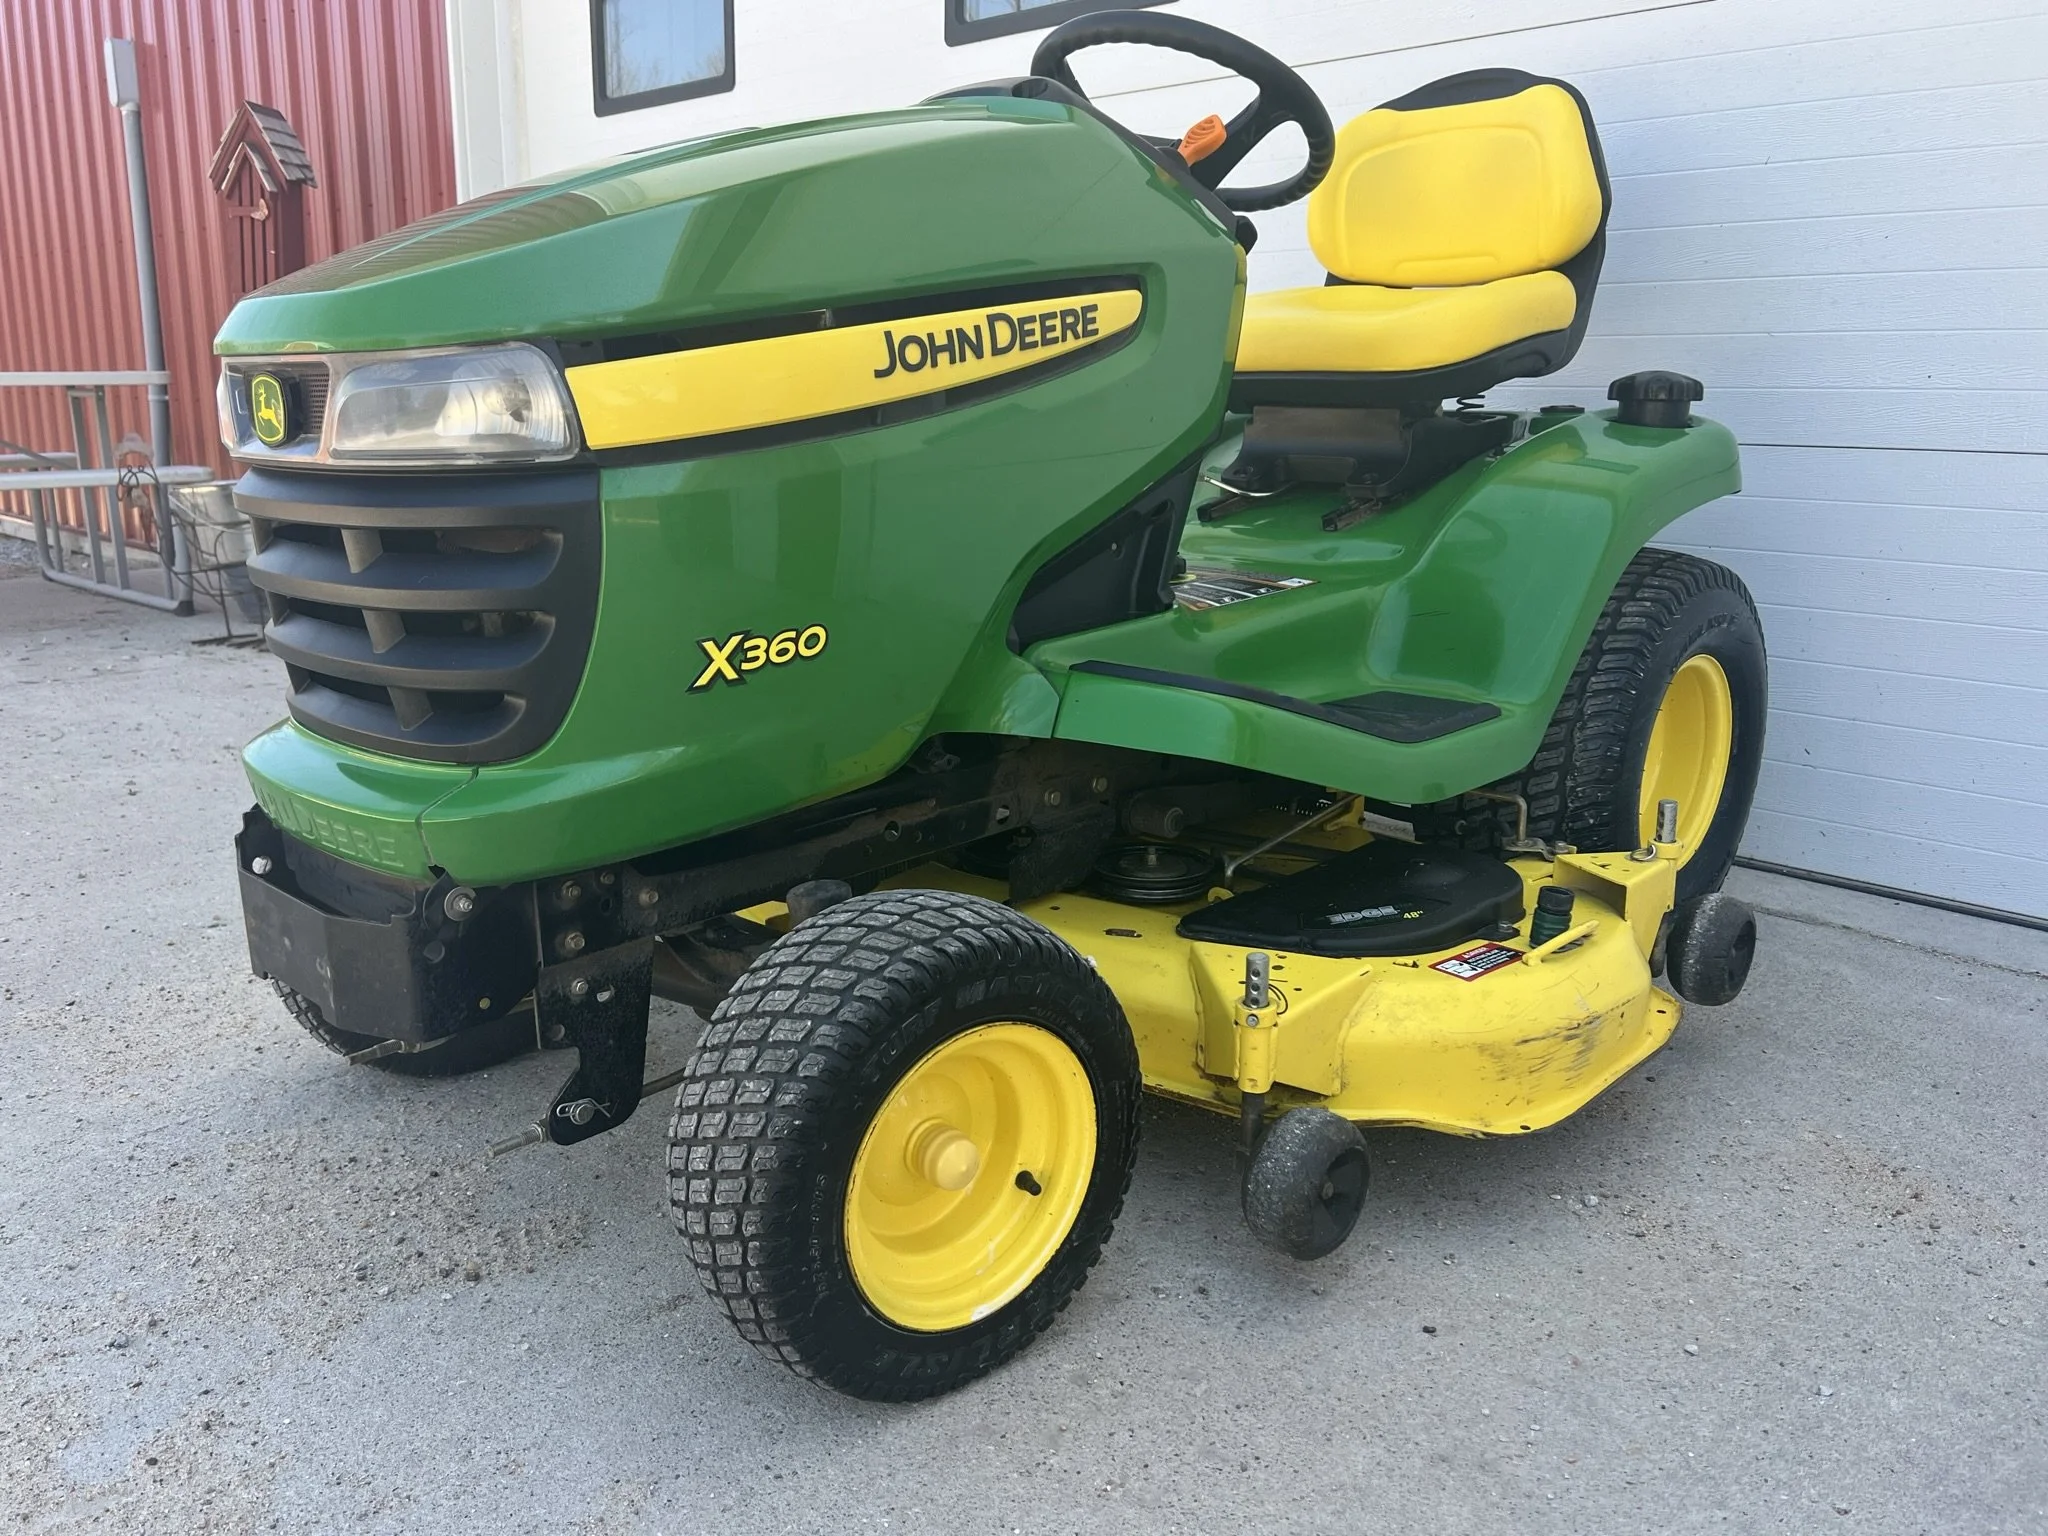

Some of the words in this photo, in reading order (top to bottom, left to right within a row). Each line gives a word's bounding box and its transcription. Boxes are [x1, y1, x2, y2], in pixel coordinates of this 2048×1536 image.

[874, 325, 984, 378] JOHN
[986, 304, 1099, 356] DEERE
[687, 624, 828, 692] X360
